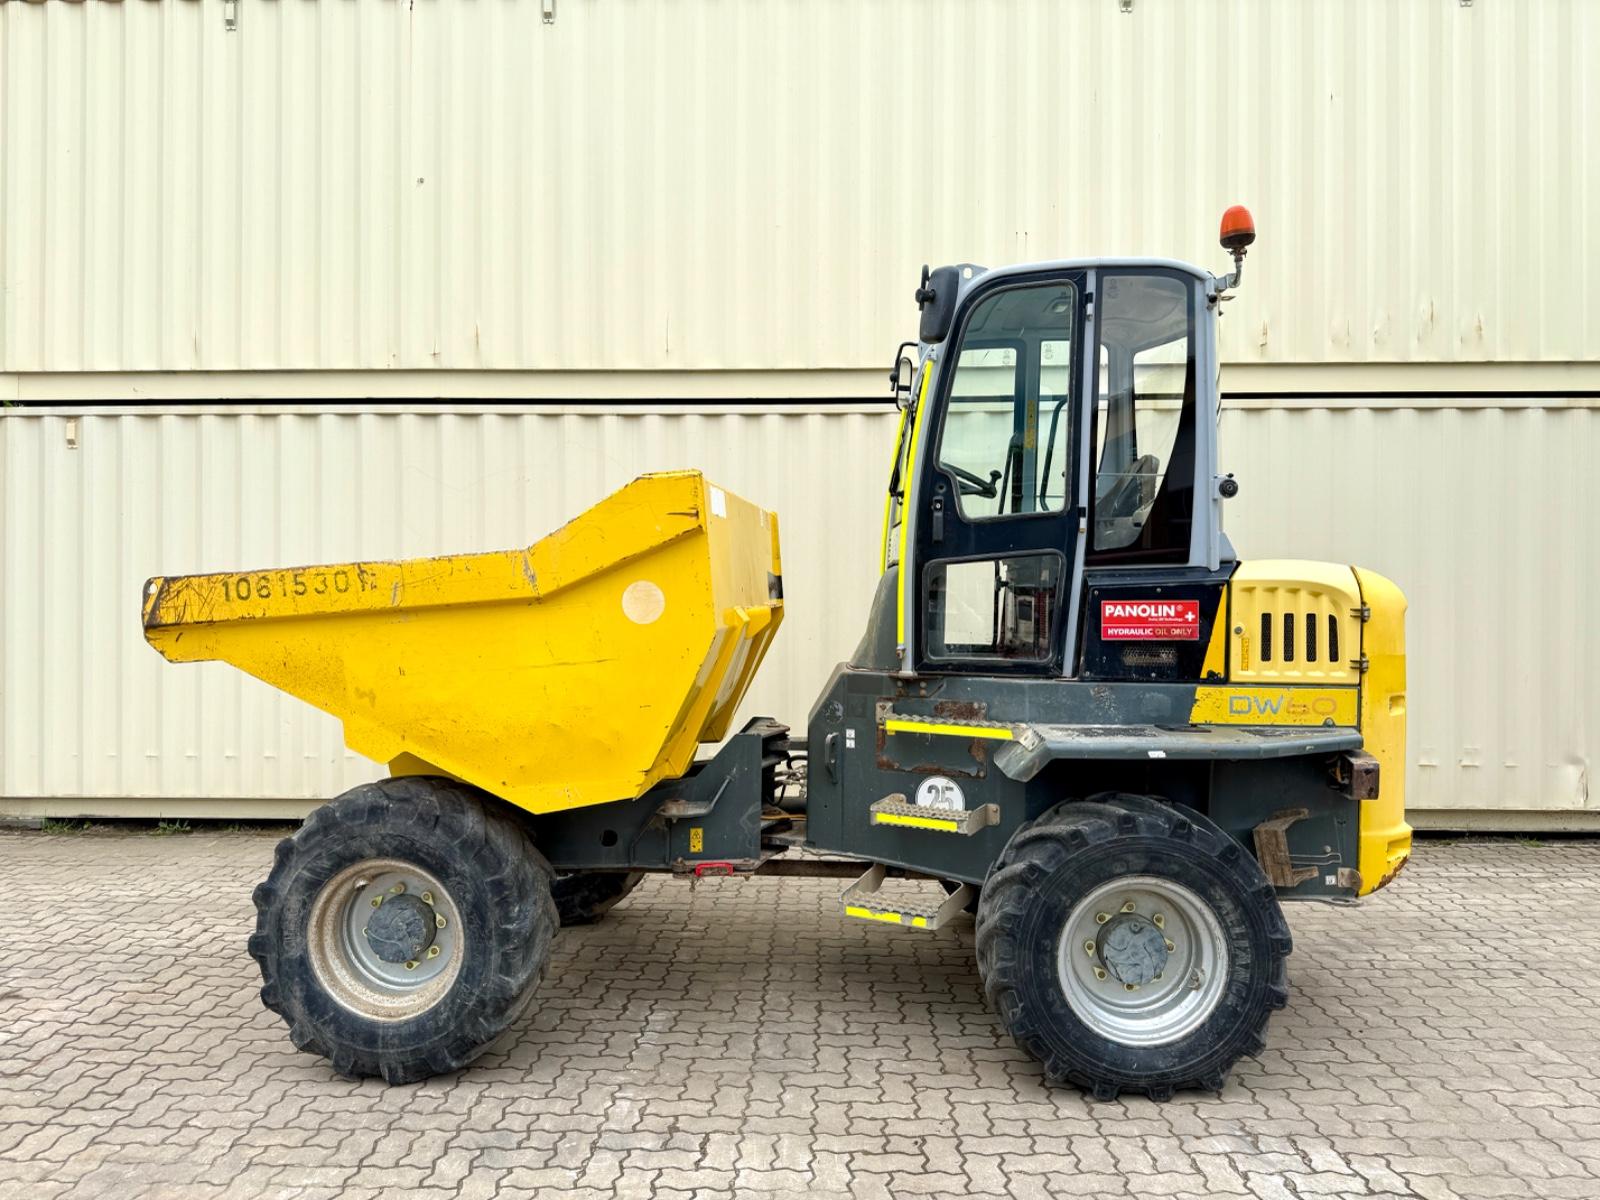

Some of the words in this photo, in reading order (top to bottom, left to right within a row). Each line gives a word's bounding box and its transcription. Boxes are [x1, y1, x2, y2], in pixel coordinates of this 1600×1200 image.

[1105, 604, 1176, 617] PANOLIN
[1107, 628, 1153, 636] HYDRAULIC
[1154, 628, 1168, 636] OIL
[1170, 628, 1192, 636] ONLY
[1229, 695, 1337, 715] DW60
[927, 784, 954, 809] 25
